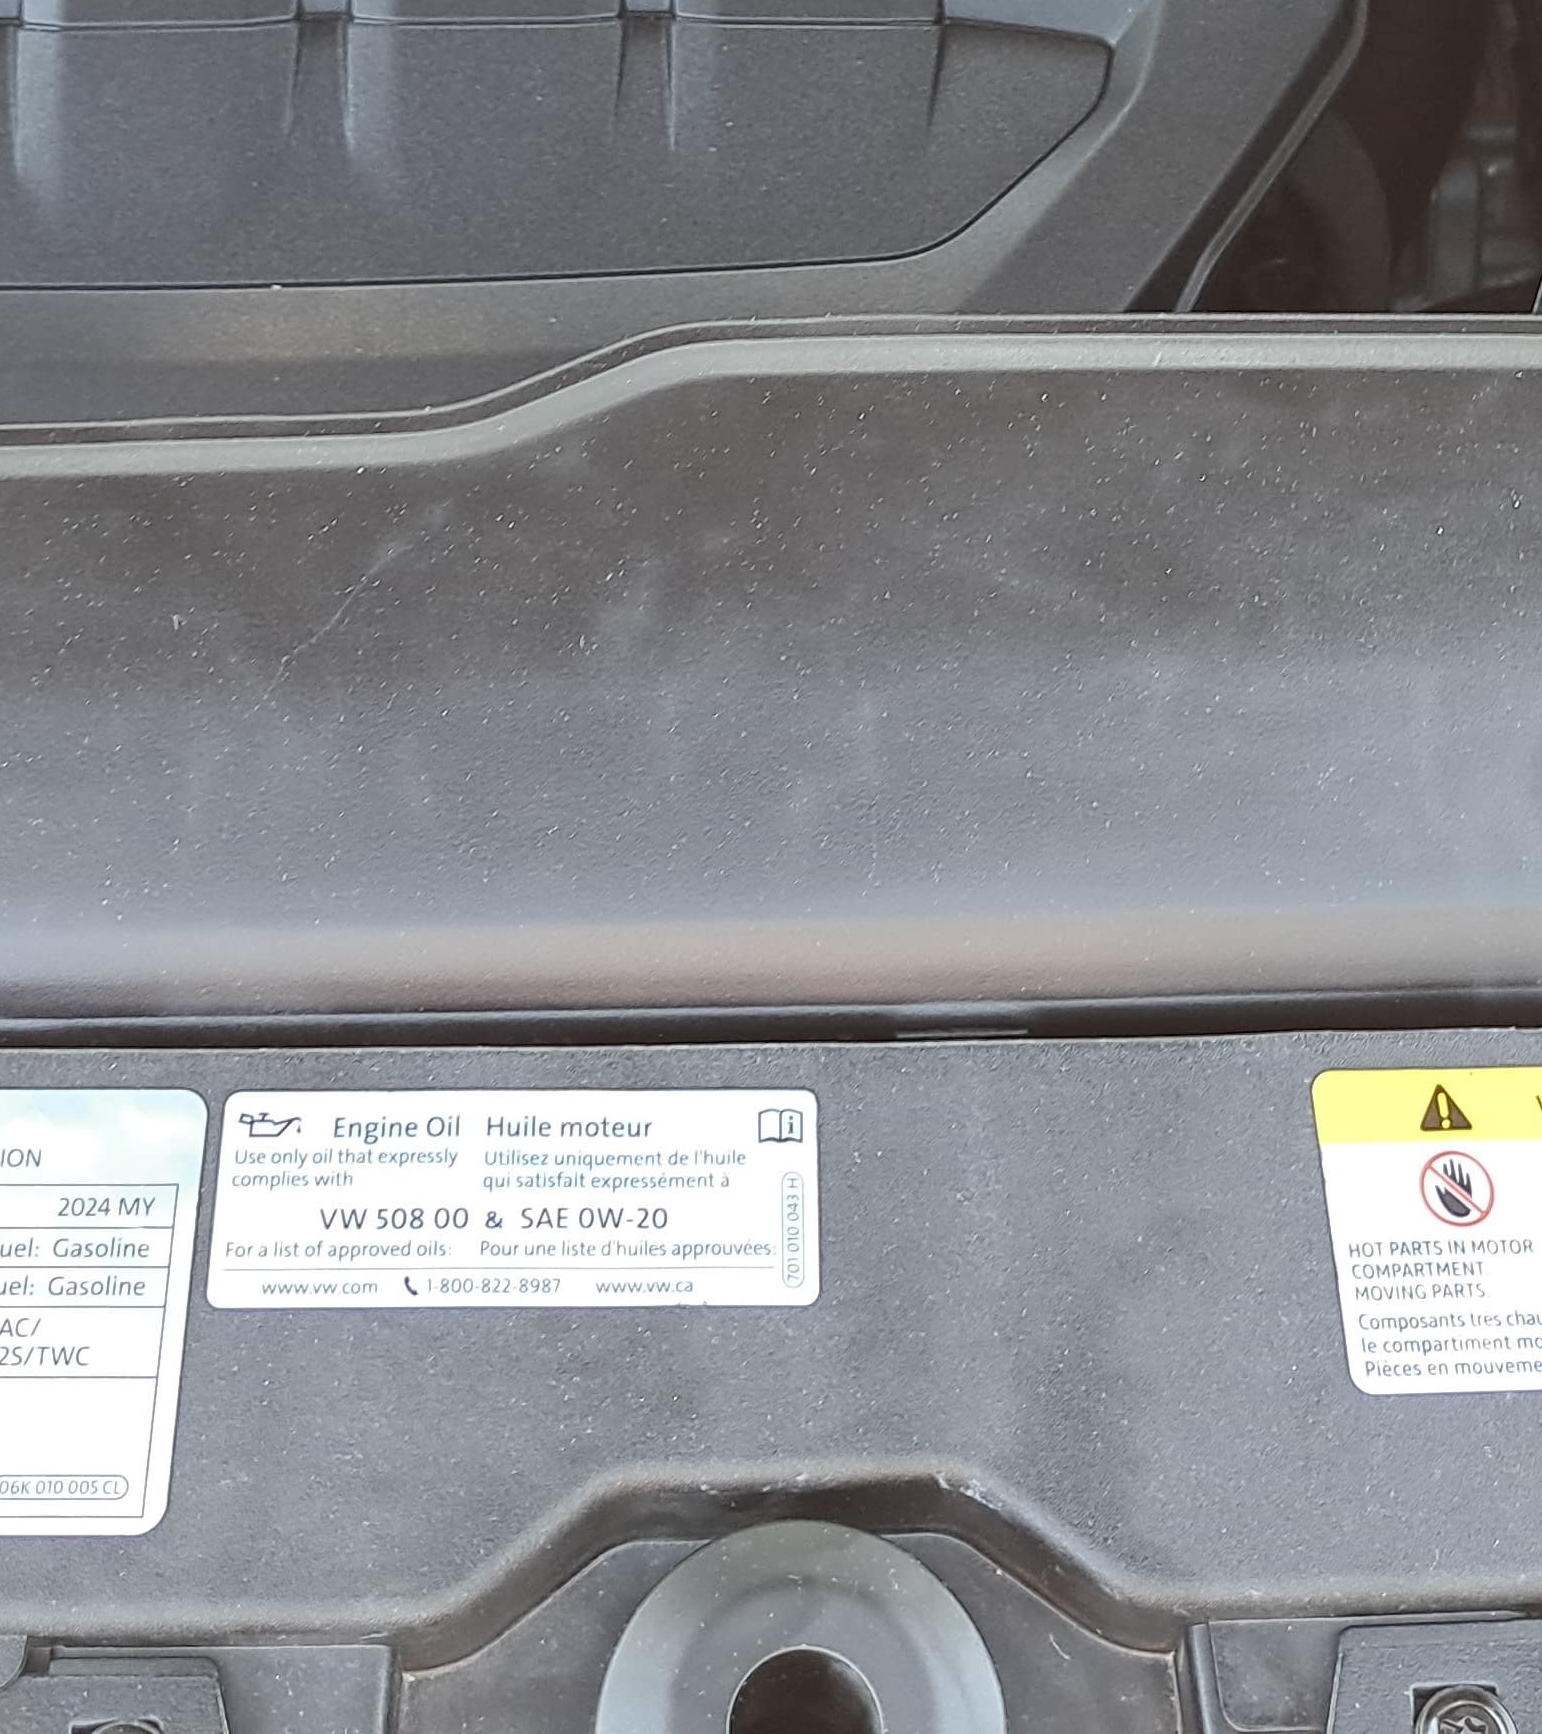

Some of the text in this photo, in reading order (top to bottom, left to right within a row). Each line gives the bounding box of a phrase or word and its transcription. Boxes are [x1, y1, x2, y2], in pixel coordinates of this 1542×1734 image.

[333, 1115, 461, 1145] Engine Oil
[486, 1116, 653, 1138] Huile moteur
[235, 1148, 458, 1169] Use only oil that expressly
[485, 1150, 746, 1170] Utilisez uniquement de l'huile
[232, 1171, 353, 1191] complies with
[483, 1172, 731, 1192] qui satisfait expressément à
[57, 1197, 156, 1217] 2024 MY
[787, 1194, 799, 1221] 043
[320, 1208, 668, 1229] VW 508 00 & SAE 0W-20
[52, 1237, 151, 1258] Gasoline
[480, 1240, 666, 1256] Pour une liste d'huiles
[787, 1227, 799, 1251] 010
[1348, 1239, 1534, 1258] HOT PARTS IN MOTOR
[226, 1242, 253, 1258] For
[274, 1241, 299, 1258] list
[305, 1240, 323, 1257] of
[328, 1240, 411, 1261] approved
[787, 1261, 799, 1281] 701
[48, 1275, 146, 1296] Gasoline
[262, 1280, 377, 1294] www.vw.com
[428, 1279, 561, 1294] 1-800-822-8987
[596, 1280, 693, 1293] www.vw.ca
[1355, 1286, 1427, 1301] MOVING
[1359, 1314, 1464, 1332] Composants
[1362, 1335, 1510, 1355] le compartiment
[1365, 1359, 1422, 1377] Pièces
[1428, 1363, 1450, 1376] en
[36, 1480, 62, 1495] 010
[68, 1480, 98, 1495] 005
[102, 1480, 121, 1495] CL
